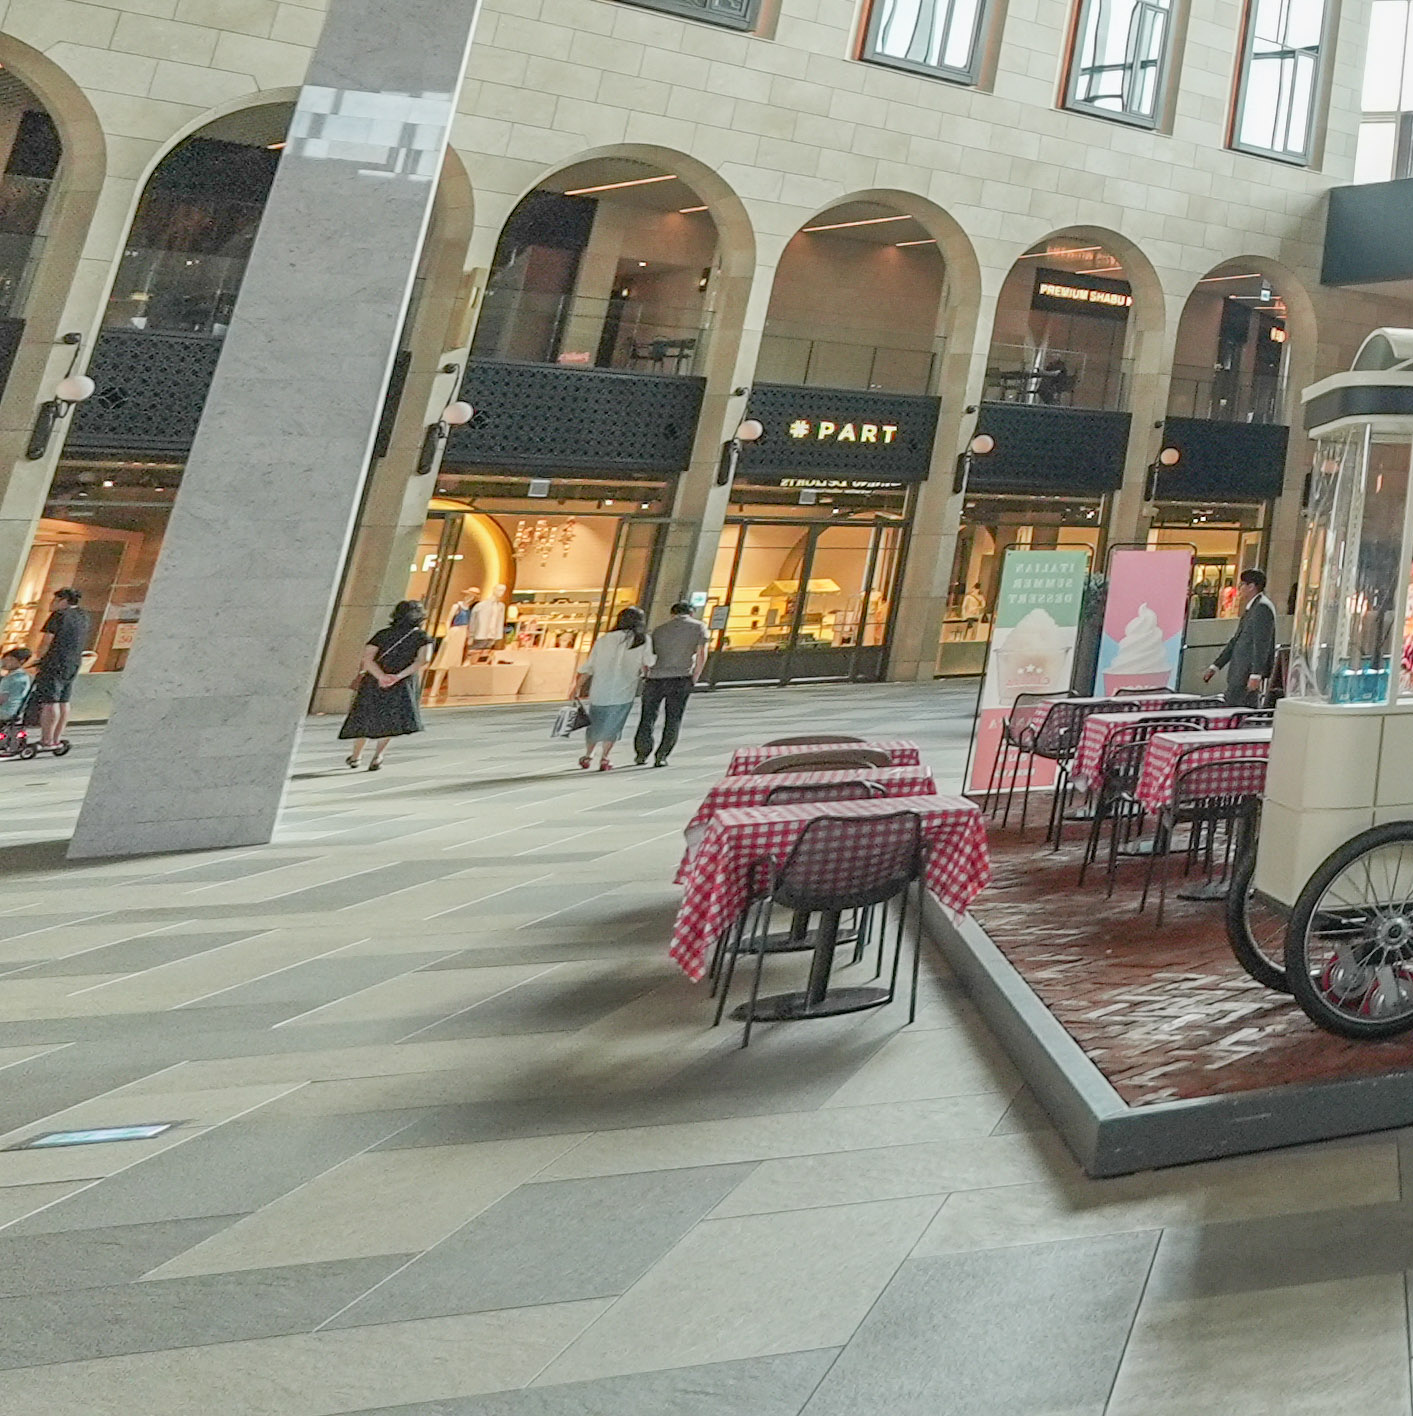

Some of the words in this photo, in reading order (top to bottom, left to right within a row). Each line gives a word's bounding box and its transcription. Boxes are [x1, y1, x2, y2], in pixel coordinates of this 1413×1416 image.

[1039, 283, 1089, 301] PREMIUM
[1089, 290, 1126, 306] SHABU
[817, 420, 898, 444] PART
